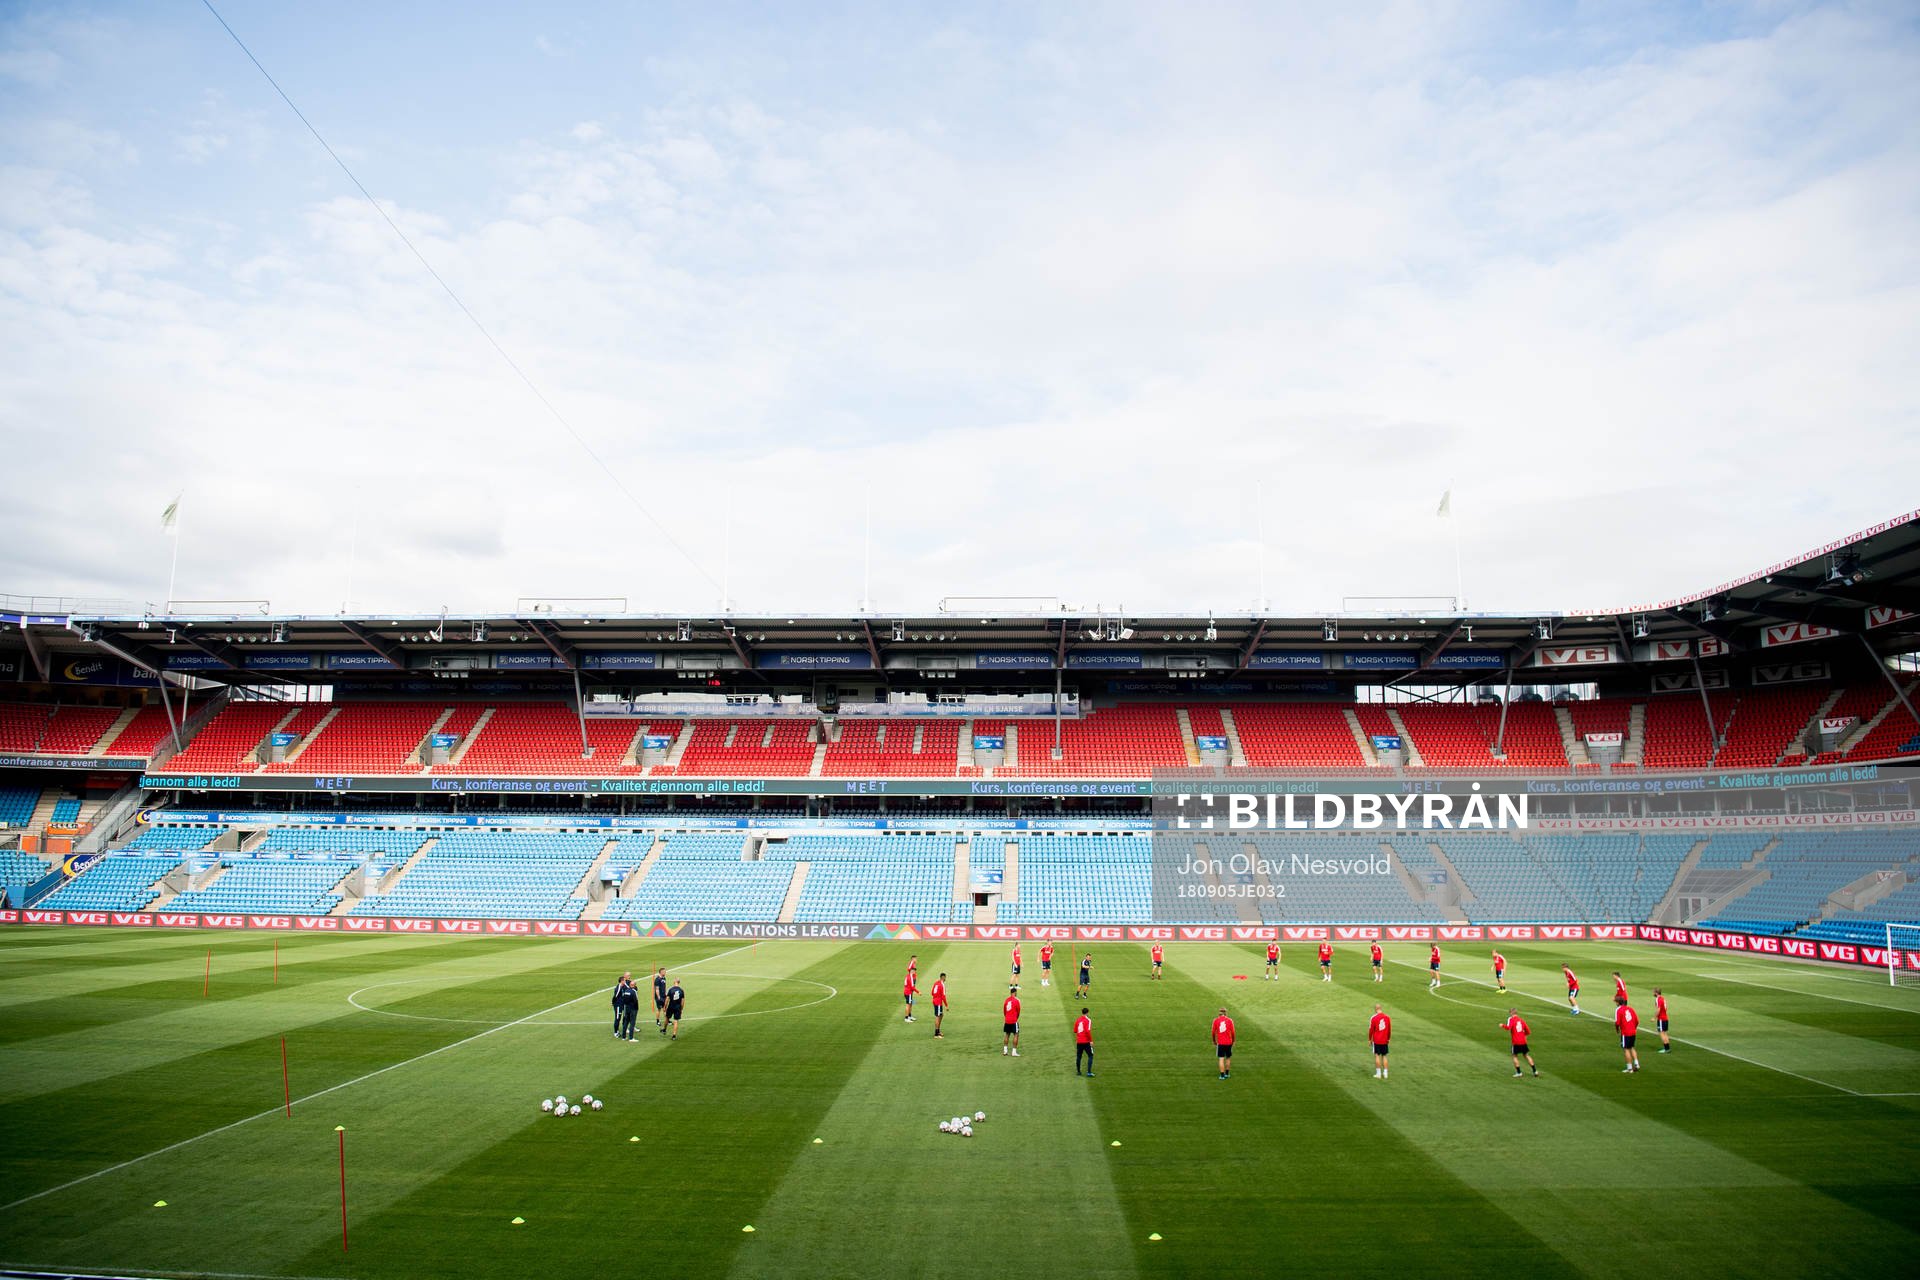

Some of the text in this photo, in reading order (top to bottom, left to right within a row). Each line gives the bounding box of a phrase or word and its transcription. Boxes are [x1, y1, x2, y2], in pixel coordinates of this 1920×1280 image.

[1769, 624, 1832, 645] VG
[1661, 638, 1718, 659] VG
[509, 656, 535, 664] NORSK
[594, 656, 653, 664] NORSK TIPPING
[790, 656, 850, 664] NORSK TIPPING
[988, 656, 1049, 664] NORSK TIPPING
[1079, 656, 1140, 664] NORSK TIPPING
[1260, 656, 1321, 664] NORSK TIPPING
[1355, 656, 1416, 664] NORSK TIPPING
[1545, 648, 1606, 664] VG
[1758, 663, 1822, 682] VG
[1657, 673, 1723, 690] VG
[1589, 734, 1619, 743] VG
[57, 760, 69, 768] og
[71, 759, 98, 768] event
[188, 776, 209, 787] alle
[211, 776, 241, 787] ledd!
[315, 778, 353, 790] MEET
[1527, 780, 1561, 793] Kurs,
[1564, 779, 1641, 792] konferanse
[1644, 781, 1662, 793] og
[1664, 777, 1705, 790] event
[1719, 774, 1770, 788] Kvalitet
[1773, 771, 1827, 788] gjennom
[1829, 768, 1849, 782] alle
[1851, 765, 1878, 781] ledd!
[432, 778, 462, 791] Kurs,
[465, 778, 532, 790] konferanse
[536, 781, 551, 792] og
[553, 780, 588, 791] event
[601, 780, 647, 792] Kvalitet
[650, 781, 704, 793] gjennom
[707, 780, 729, 792] alle
[733, 780, 766, 792] ledd!
[847, 780, 888, 793] MEET
[971, 782, 1004, 794] Kurs,
[1007, 782, 1078, 794] konferanse
[1081, 785, 1098, 795] og
[1100, 783, 1136, 794] event
[1151, 782, 1198, 793] Kvalitet
[1261, 782, 1283, 793] alle
[1287, 782, 1319, 794] ledd!
[1402, 781, 1443, 793] MEET
[1703, 817, 1738, 826] VG
[1744, 817, 1778, 825] VG
[1785, 816, 1816, 825] VG
[1823, 814, 1852, 824] VG
[1857, 812, 1885, 822] VG
[1891, 811, 1916, 821] VG
[1579, 820, 1612, 828] VG
[1661, 819, 1696, 827] VG
[0, 911, 16, 921] G
[25, 912, 62, 922] VG
[68, 912, 107, 923] VG
[112, 913, 151, 924] VG
[158, 914, 197, 925] VG
[203, 916, 243, 926] VG
[252, 917, 290, 927] VG
[298, 918, 336, 928] VG
[346, 919, 385, 929] VG
[393, 920, 433, 930] VG
[439, 920, 480, 931] VG
[488, 921, 528, 932] VG
[537, 922, 578, 932] VG
[587, 923, 627, 933] VG
[692, 923, 859, 937] UEFA NATIONS LEAGUE
[924, 927, 968, 937] VG
[977, 927, 1018, 937] VG
[1027, 927, 1070, 938] VG
[1078, 927, 1121, 938] VG
[1129, 927, 1172, 938] VG
[1181, 927, 1225, 938] VG
[1233, 927, 1276, 938] VG
[1284, 927, 1327, 938] VG
[1336, 927, 1380, 938] VG
[1388, 927, 1430, 938] VG
[1438, 927, 1481, 938] VG
[1489, 927, 1532, 937] VG
[1540, 927, 1584, 937] VG
[1591, 926, 1634, 937] VG
[1640, 926, 1661, 939] VG
[1664, 928, 1687, 942] VG
[1690, 931, 1714, 945] VG
[1718, 934, 1745, 948] VG
[1749, 938, 1778, 951] VG
[1782, 940, 1815, 956] VG
[1820, 944, 1856, 961] VG
[1863, 949, 1900, 966] VG
